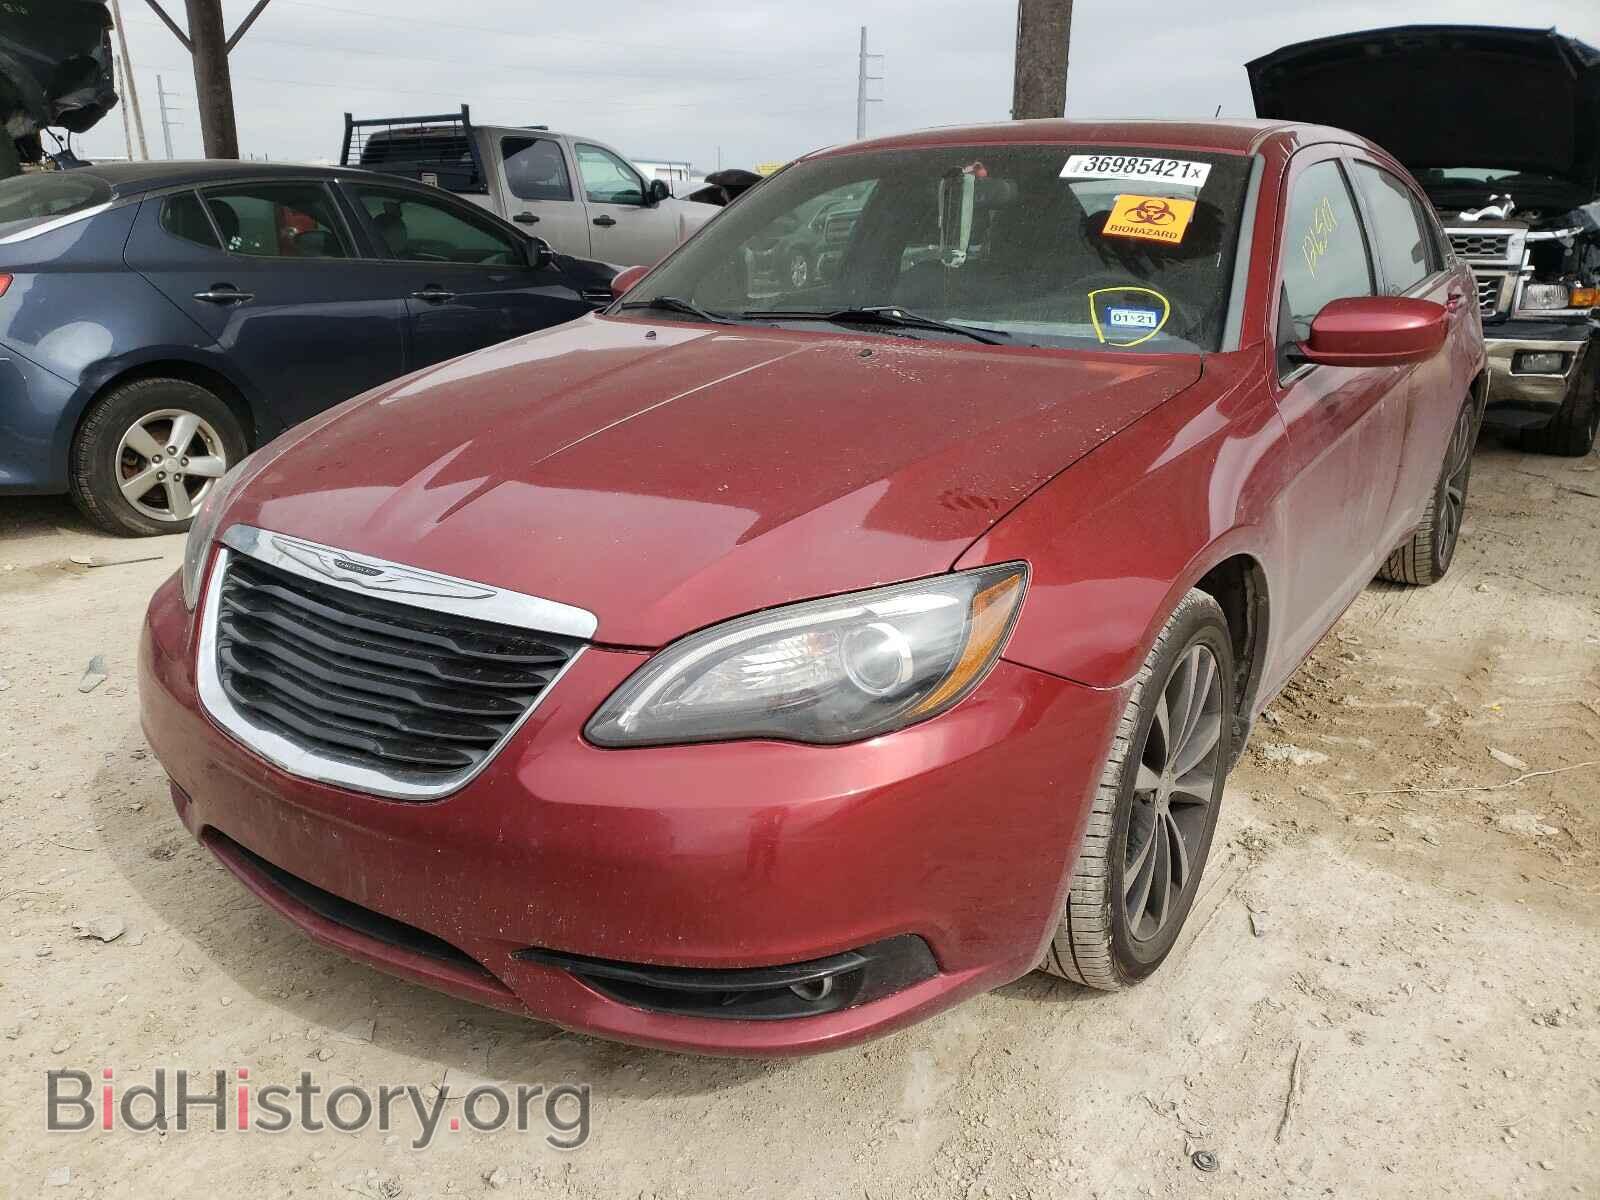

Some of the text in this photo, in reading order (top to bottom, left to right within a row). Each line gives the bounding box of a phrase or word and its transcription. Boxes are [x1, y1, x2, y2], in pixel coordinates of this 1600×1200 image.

[1109, 224, 1178, 239] BIOHAZARD
[1113, 313, 1128, 322] 01
[1136, 315, 1152, 324] 21
